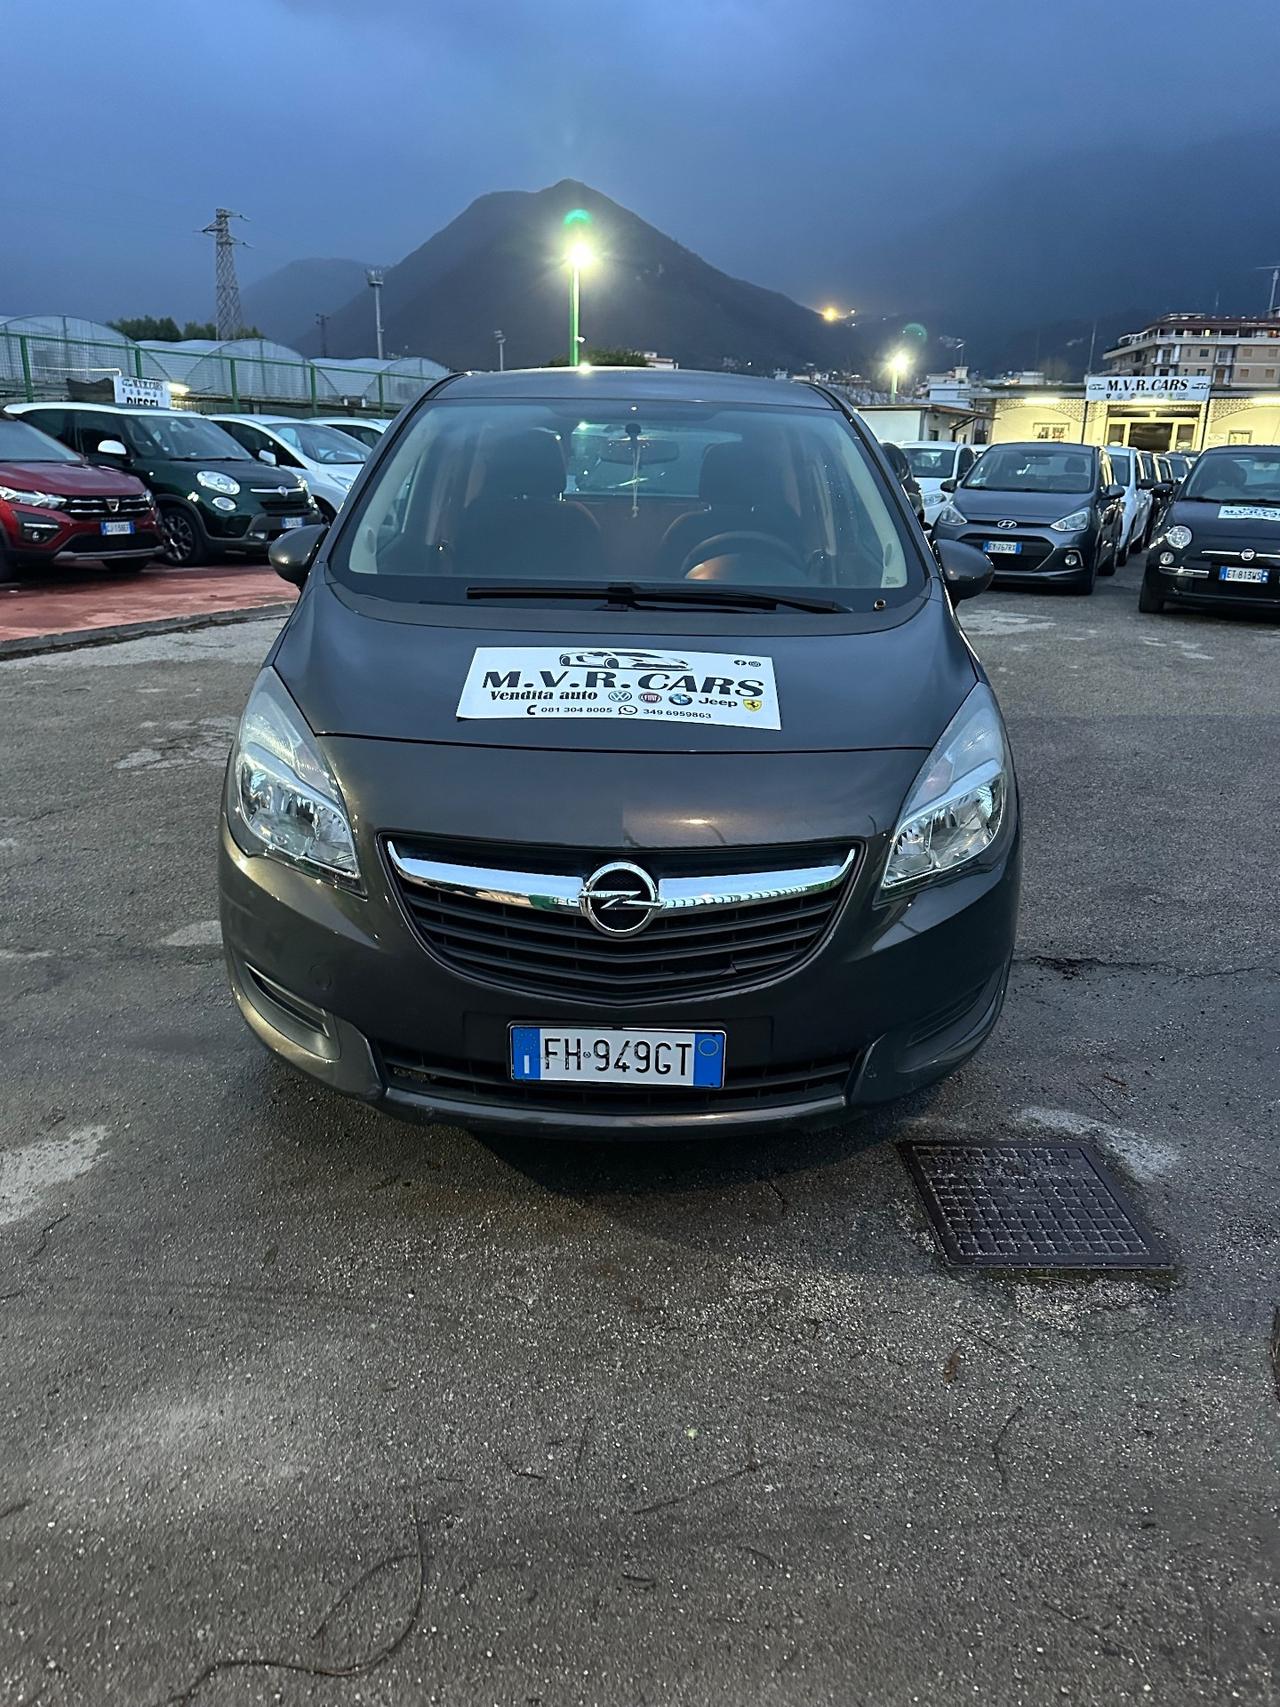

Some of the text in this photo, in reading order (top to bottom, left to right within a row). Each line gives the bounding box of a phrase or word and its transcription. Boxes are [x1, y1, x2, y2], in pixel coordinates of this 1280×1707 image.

[490, 690, 554, 700] Vendita
[559, 690, 598, 700] auto
[698, 697, 738, 708] Jeep
